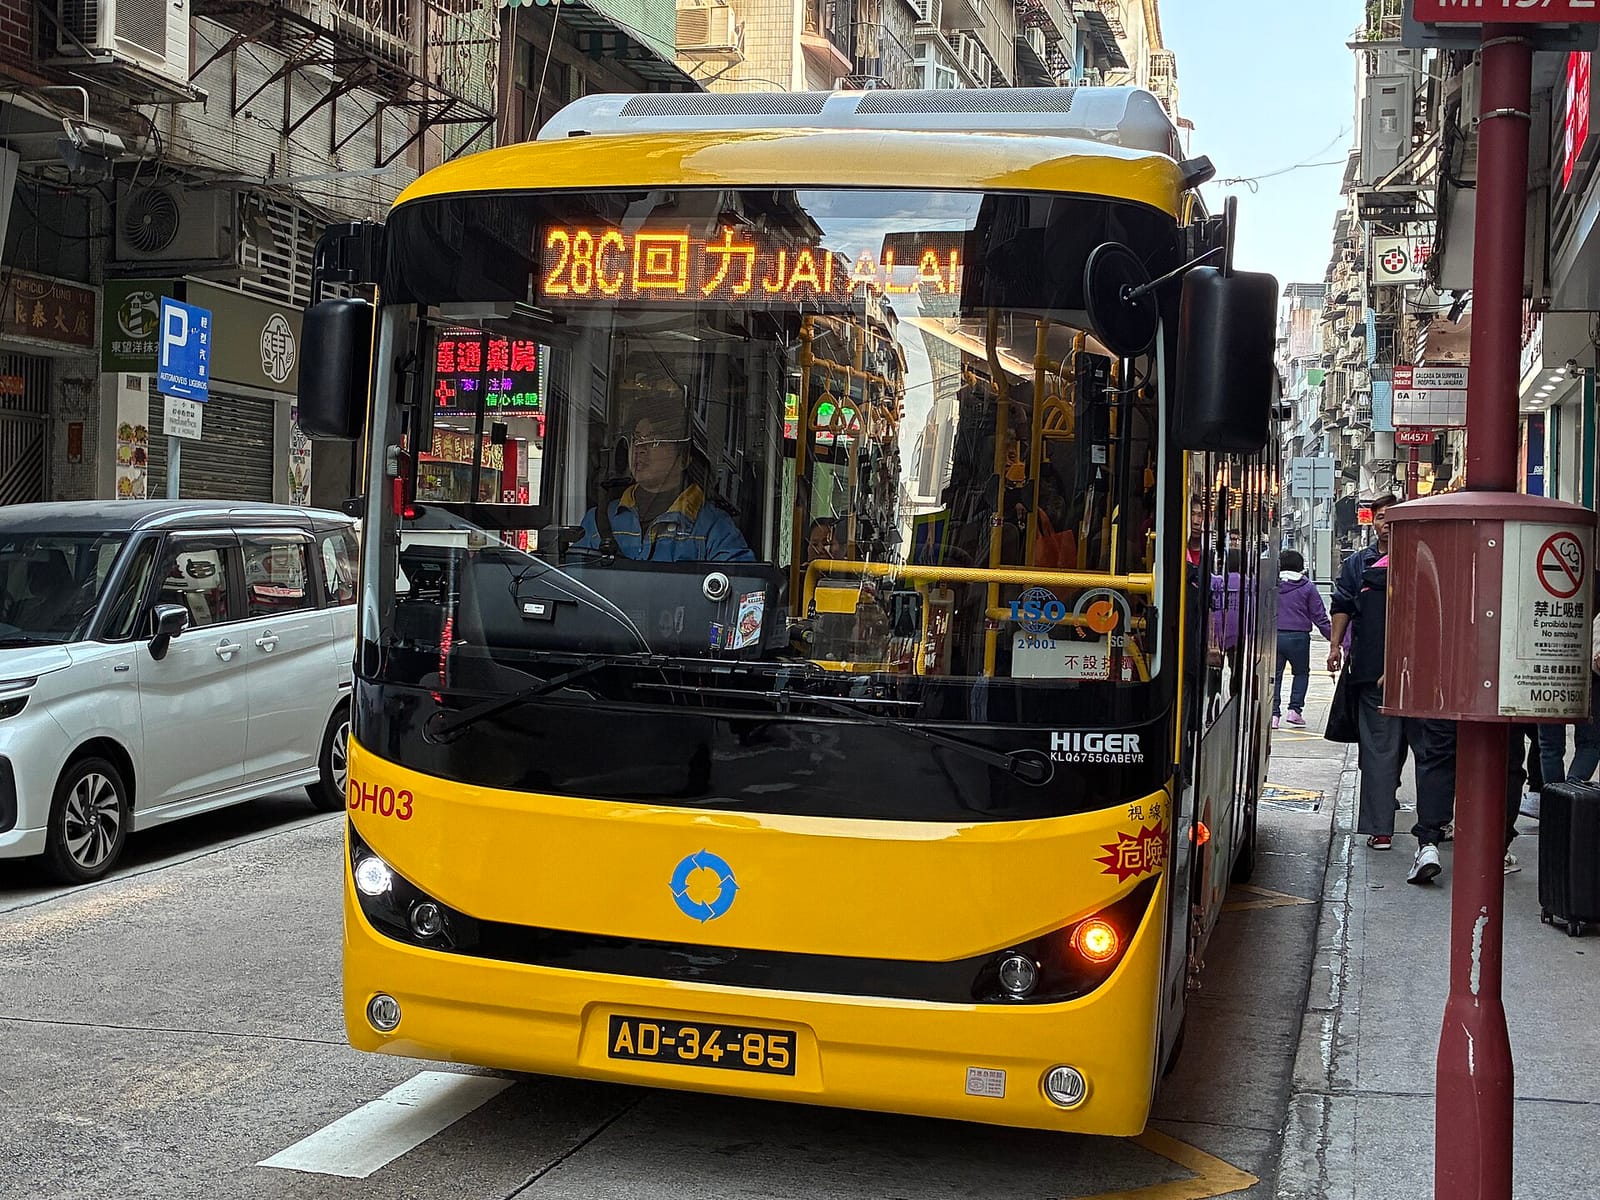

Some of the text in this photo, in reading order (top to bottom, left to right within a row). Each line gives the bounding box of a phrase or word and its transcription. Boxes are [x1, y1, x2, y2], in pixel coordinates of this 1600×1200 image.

[544, 225, 957, 295] 28C 回力 JAI ALAI
[162, 304, 188, 367] P
[1397, 392, 1427, 400] 6A 17
[1008, 600, 1066, 621] ISO
[1534, 601, 1584, 618] 禁止吸煙
[1540, 620, 1568, 629] proibido
[1542, 629, 1579, 640] No smoking
[1018, 639, 1056, 650] 27001
[1051, 732, 1141, 753] HIGER
[1051, 751, 1144, 764] KLQ6755GABEVR
[349, 778, 414, 821] DH03
[1116, 837, 1163, 869] 危險
[614, 1021, 790, 1069] AD-34-85
